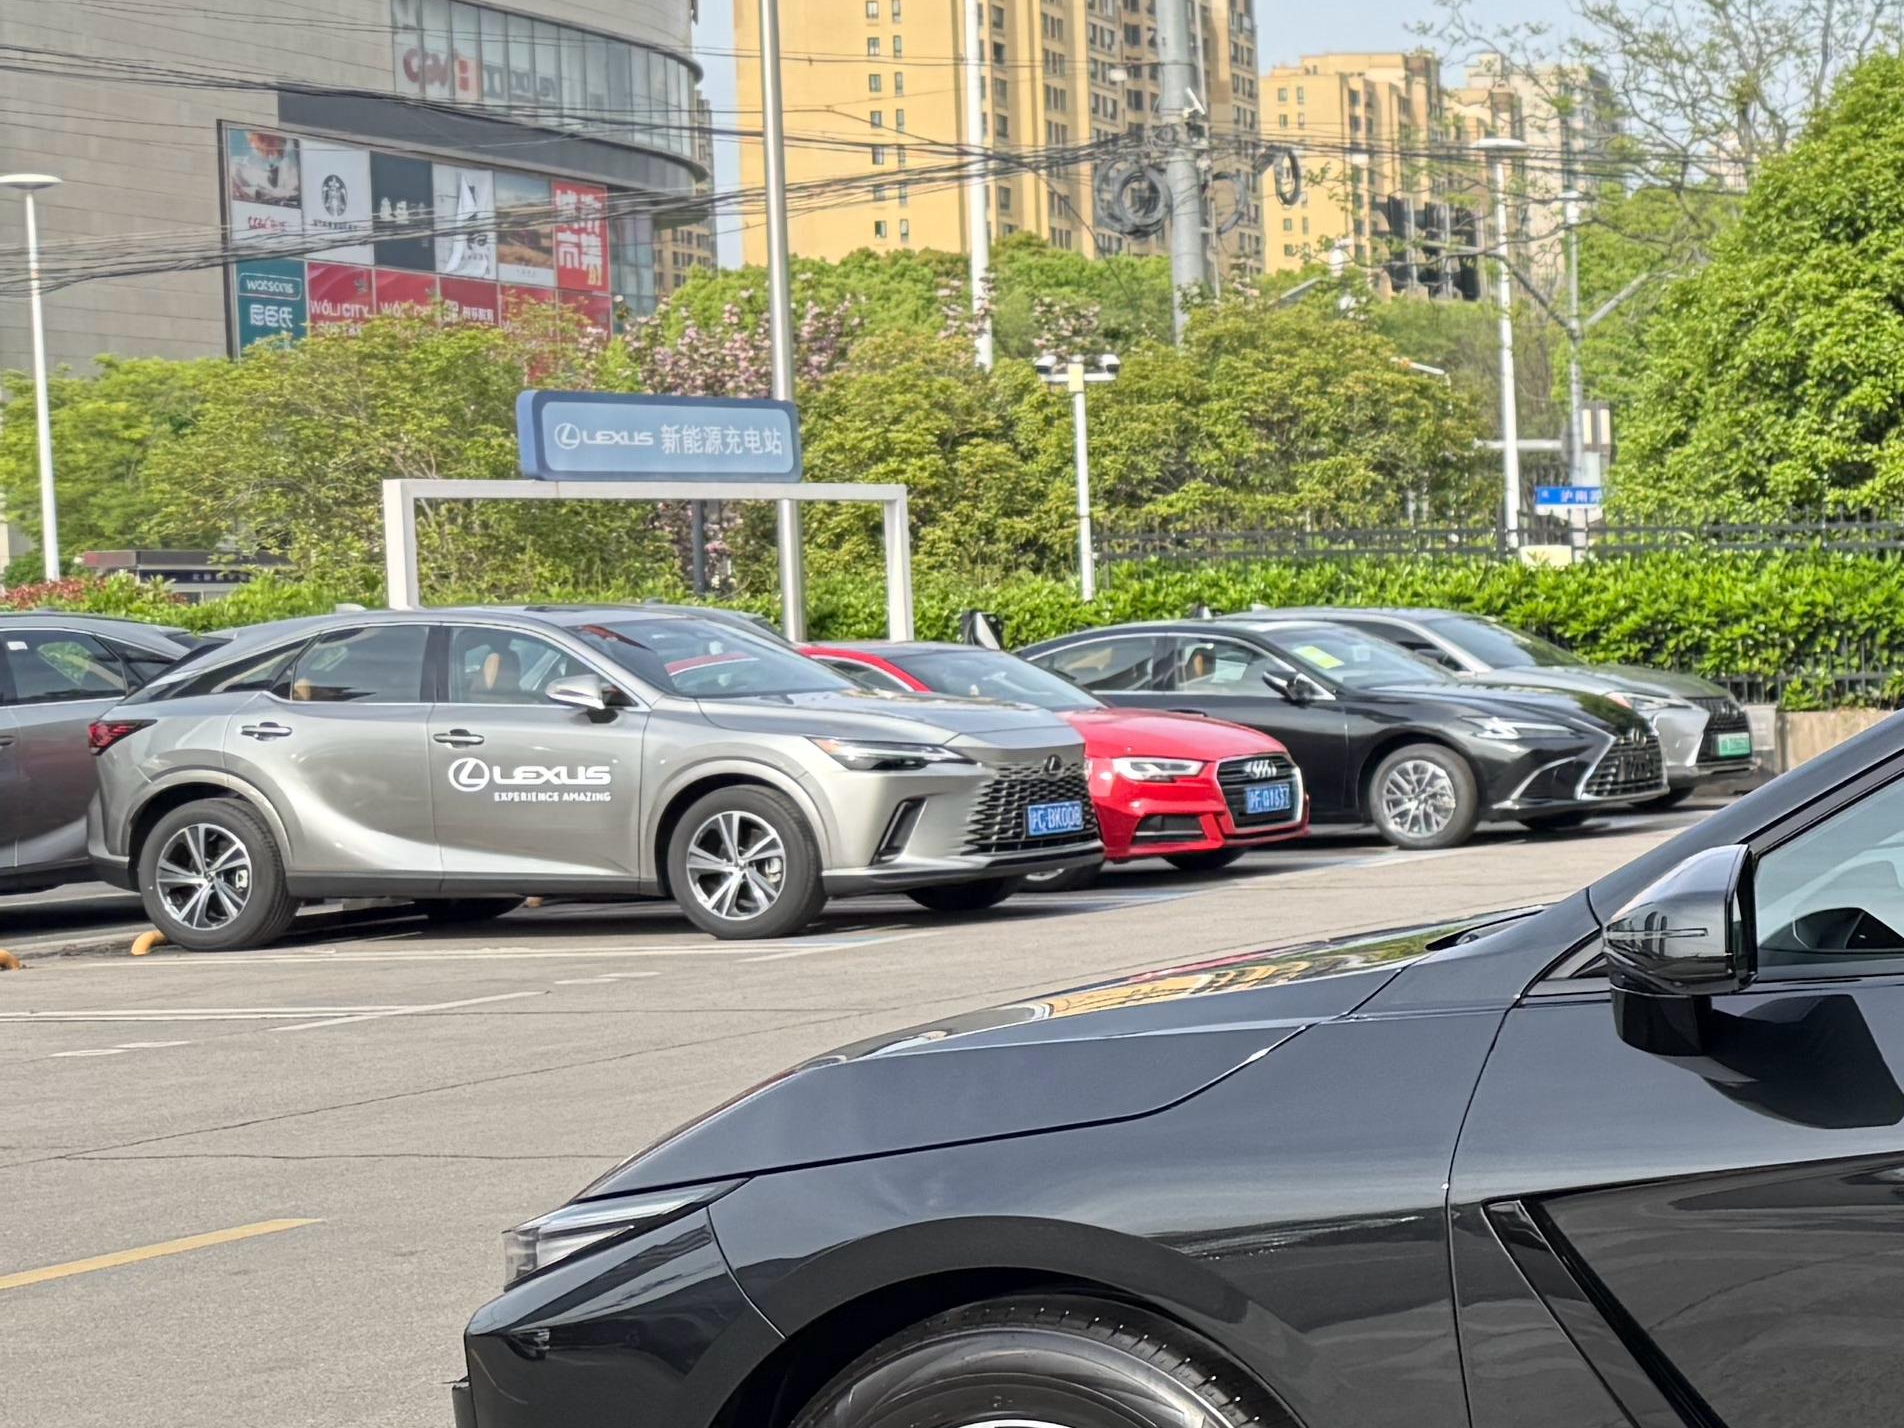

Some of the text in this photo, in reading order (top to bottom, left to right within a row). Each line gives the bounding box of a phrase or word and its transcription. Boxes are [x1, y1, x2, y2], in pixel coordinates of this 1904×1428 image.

[582, 424, 783, 455] LEXUS 新能源充电站
[493, 765, 612, 785] LEXUS
[494, 791, 612, 802] EXPERIENCE AMAZING
